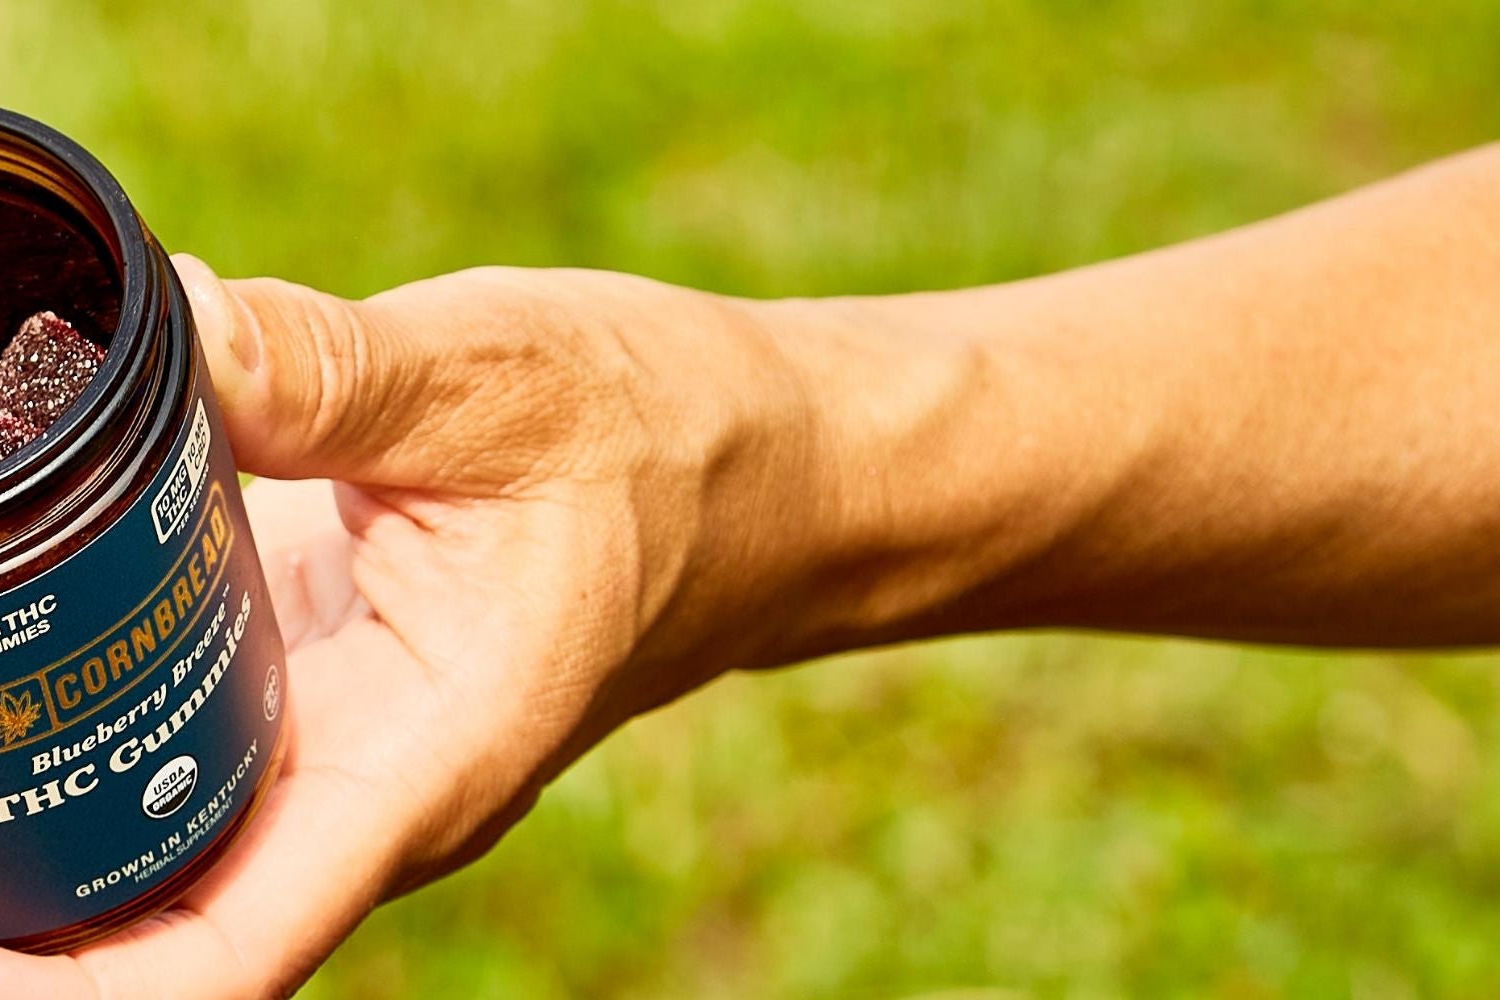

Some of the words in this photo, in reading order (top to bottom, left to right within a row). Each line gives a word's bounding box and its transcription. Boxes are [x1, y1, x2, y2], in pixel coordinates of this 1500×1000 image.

[156, 494, 171, 518] 10
[170, 465, 188, 499] MG
[165, 485, 188, 523] THC
[1, 594, 58, 631] THC
[54, 505, 226, 710] CORNBREAD
[109, 591, 251, 773] Gummies
[31, 683, 168, 776] Blueberry
[152, 774, 193, 812] ORGANIC
[153, 766, 186, 796] USDA
[75, 850, 155, 897] GROWN
[160, 831, 182, 854] IN
[186, 738, 259, 835] KENTUCKY
[134, 853, 177, 883] HERBAL
[177, 796, 234, 856] SUPPLEMENT
